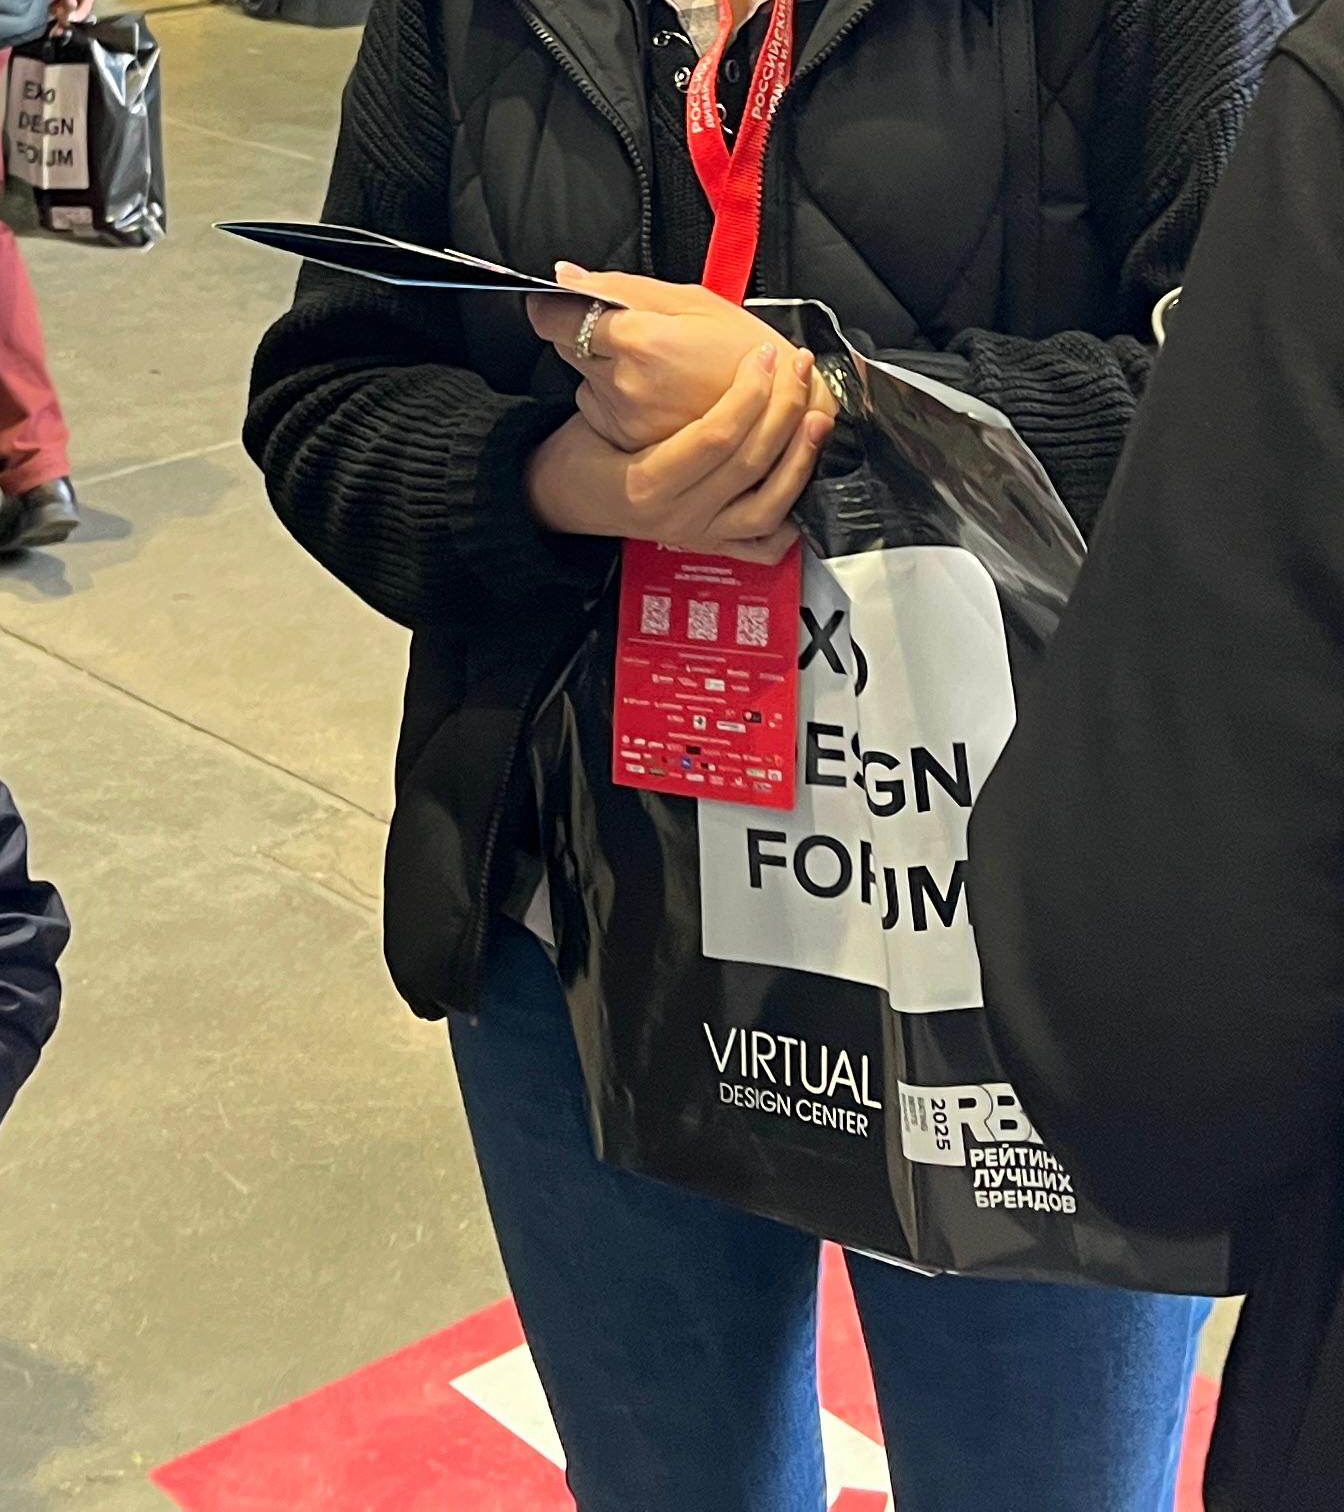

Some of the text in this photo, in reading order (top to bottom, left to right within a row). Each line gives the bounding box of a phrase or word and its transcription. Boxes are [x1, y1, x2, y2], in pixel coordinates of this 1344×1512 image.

[703, 1022, 882, 1110] VIRTUAL
[719, 1082, 791, 1117] DESIGN
[795, 1099, 869, 1138] CENTER
[930, 1098, 951, 1151] 2025
[969, 1143, 1064, 1172] РЕЙТИН
[973, 1168, 1074, 1193] ЛУЧШИХ
[974, 1189, 1077, 1214] БРЕНДОВ
